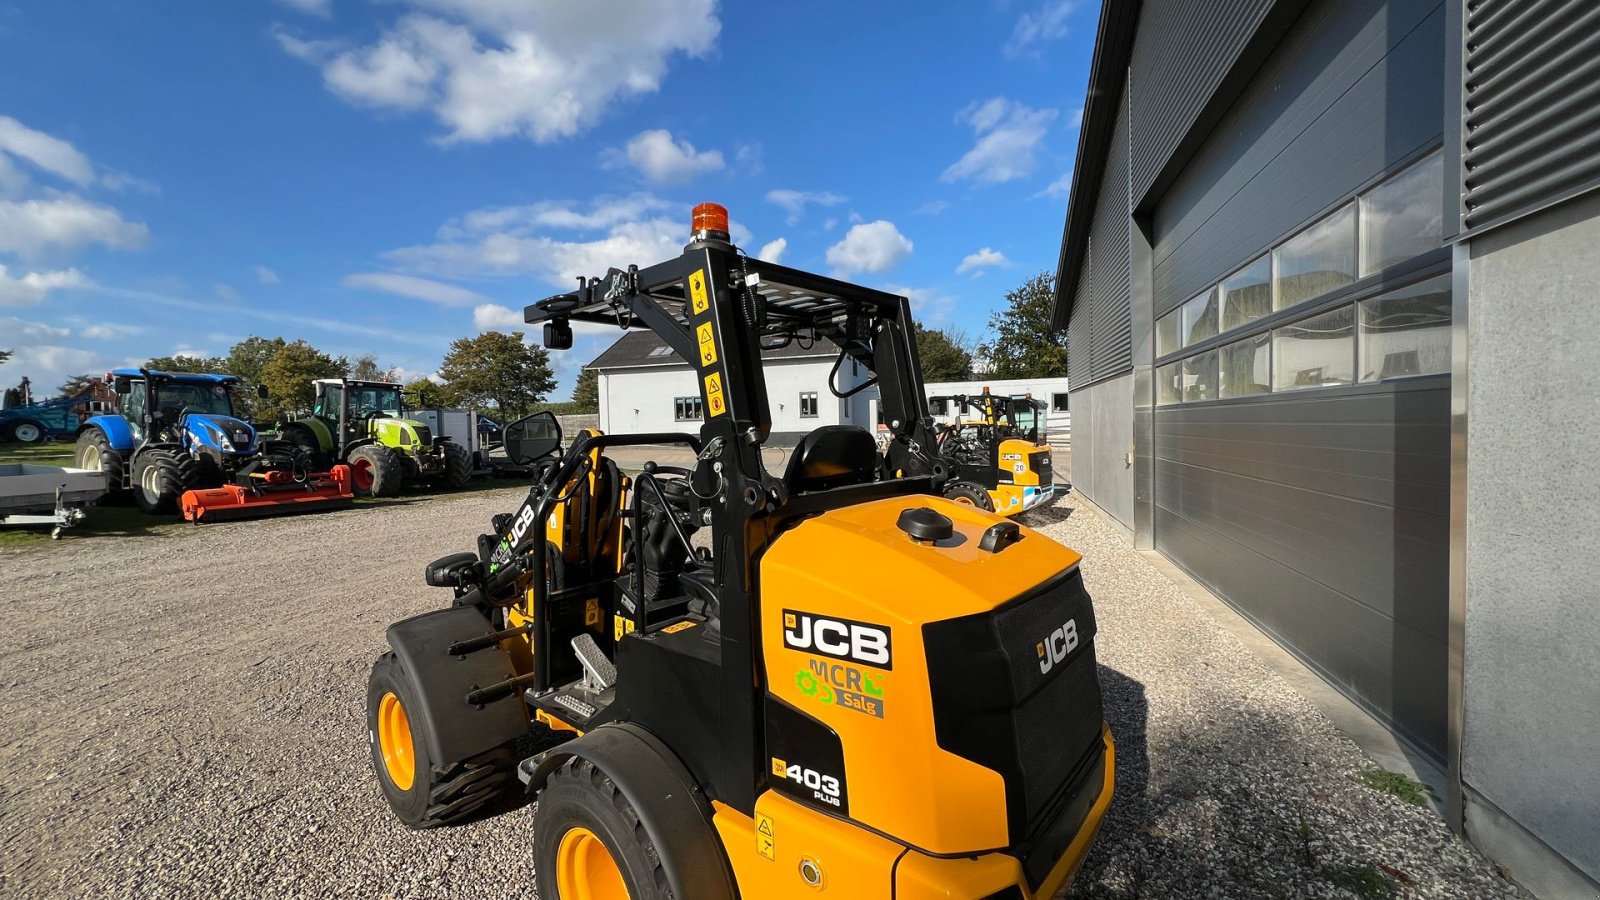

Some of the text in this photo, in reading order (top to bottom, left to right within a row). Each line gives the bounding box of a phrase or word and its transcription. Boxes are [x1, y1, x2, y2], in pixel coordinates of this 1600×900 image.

[510, 504, 535, 548] JCB
[784, 615, 889, 664] JCB
[1039, 618, 1079, 675] JCB
[809, 658, 863, 693] MCR
[843, 693, 876, 716] Salg
[786, 763, 841, 798] 403
[813, 791, 841, 807] PLUS
